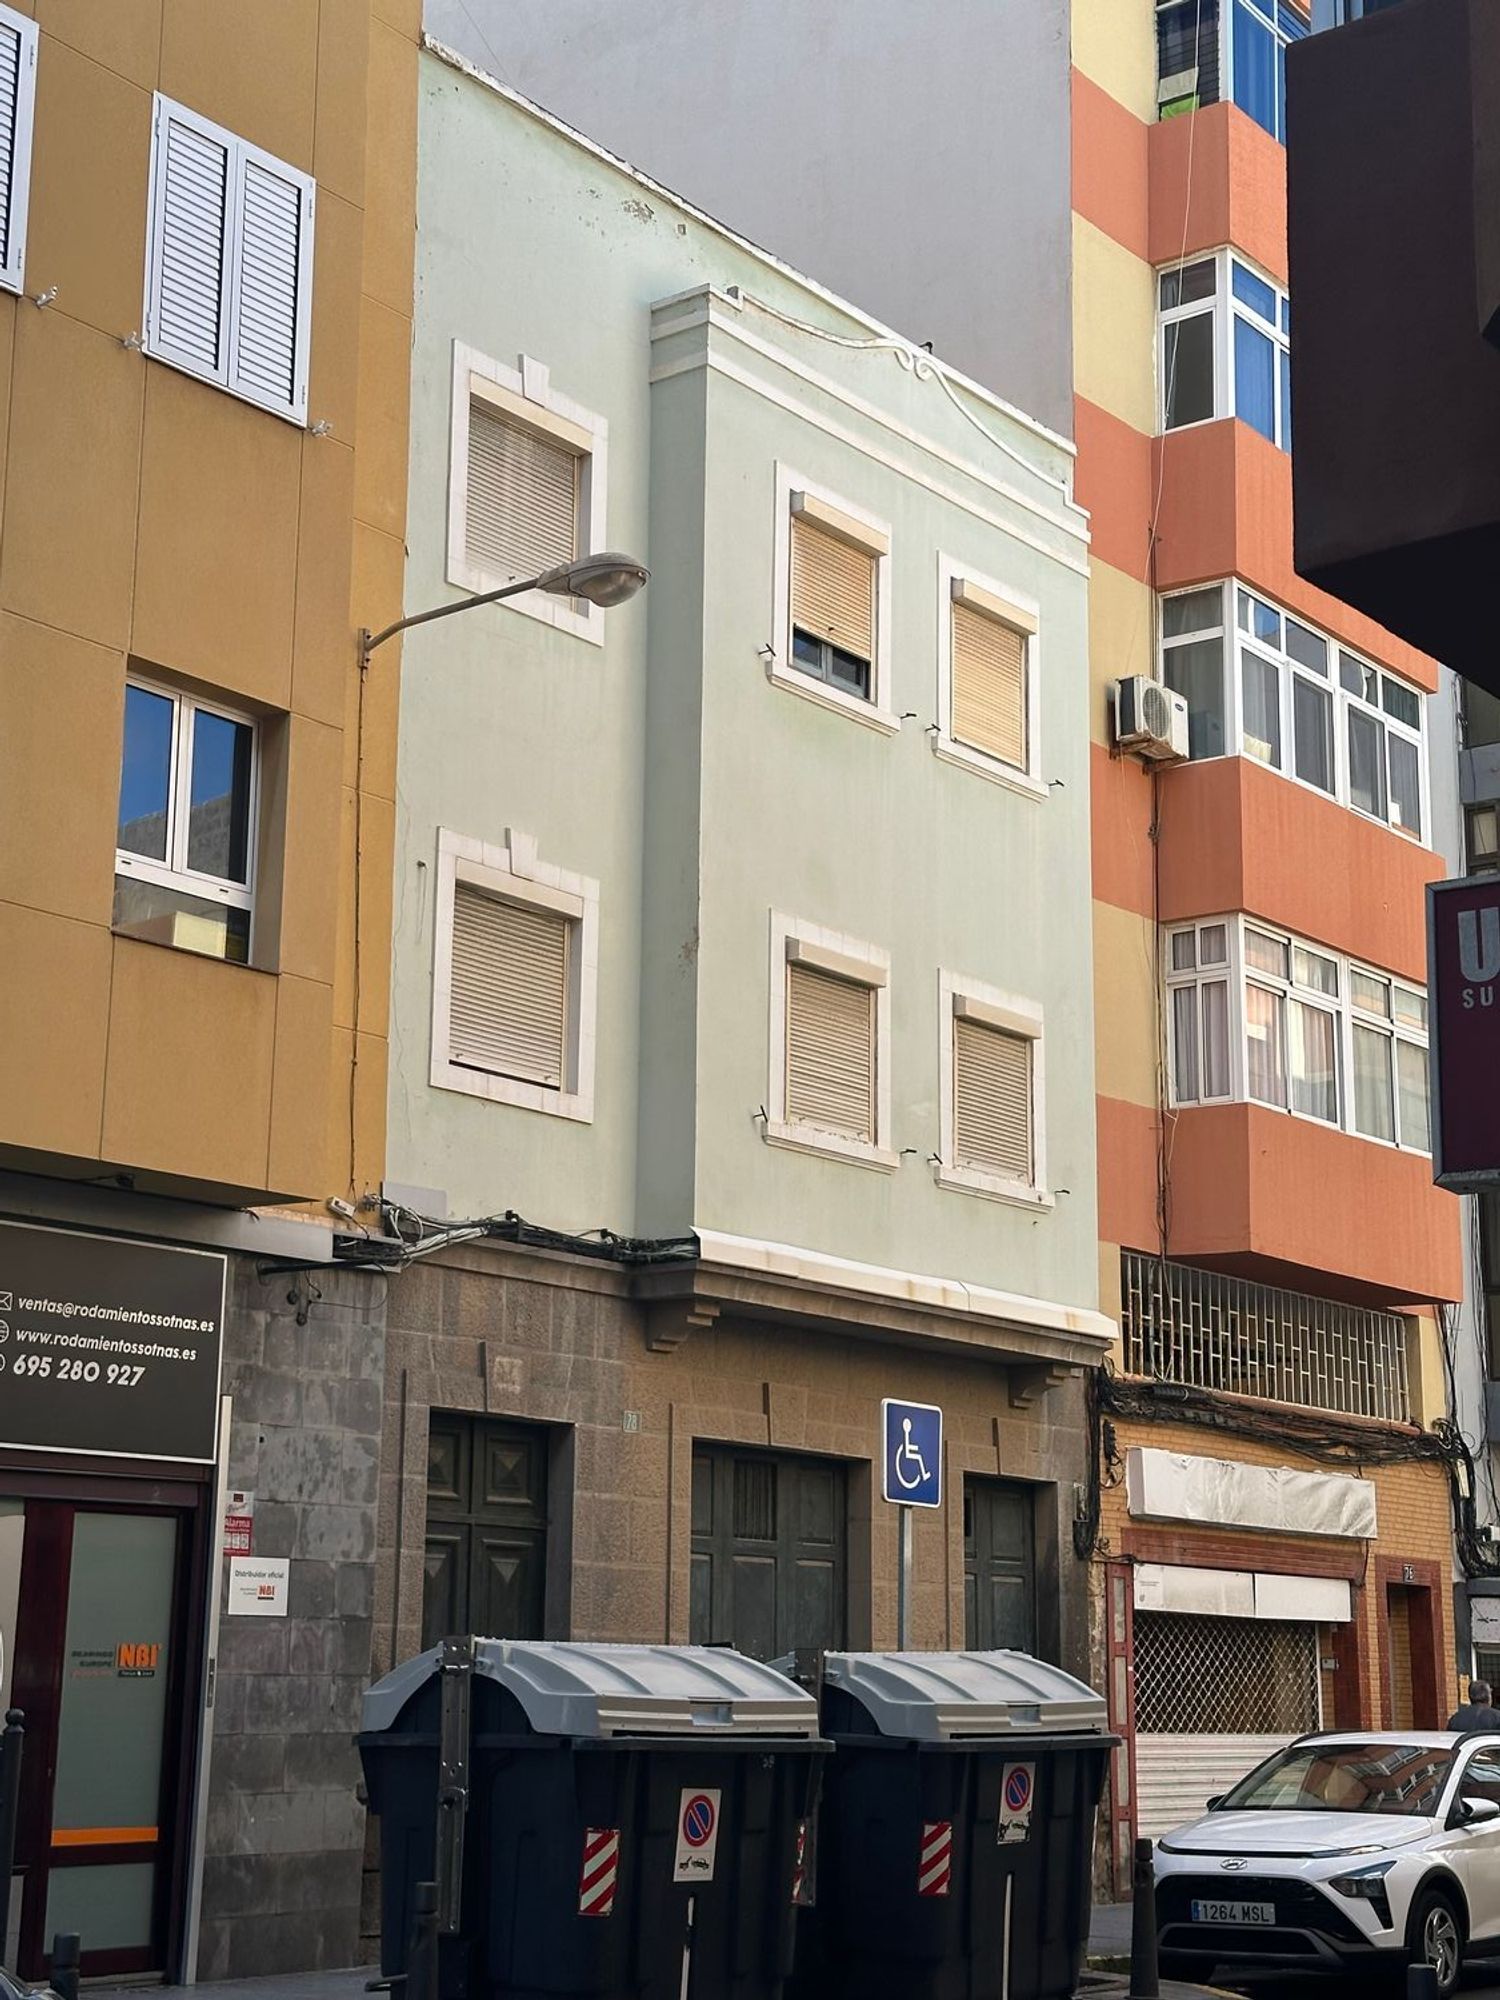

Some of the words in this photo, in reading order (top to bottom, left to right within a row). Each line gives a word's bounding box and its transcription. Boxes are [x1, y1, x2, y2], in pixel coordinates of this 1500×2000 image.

[18, 1296, 214, 1332] ventas@rodamientossotnas.es
[16, 1329, 196, 1360] www.rodamientossotnas.es
[13, 1353, 53, 1378] 695
[56, 1358, 101, 1383] 280
[106, 1365, 145, 1387] 927
[258, 1585, 275, 1596] NBI
[118, 1643, 157, 1667] NBI
[1203, 1904, 1236, 1920] 1264
[1242, 1905, 1269, 1922] MSL
